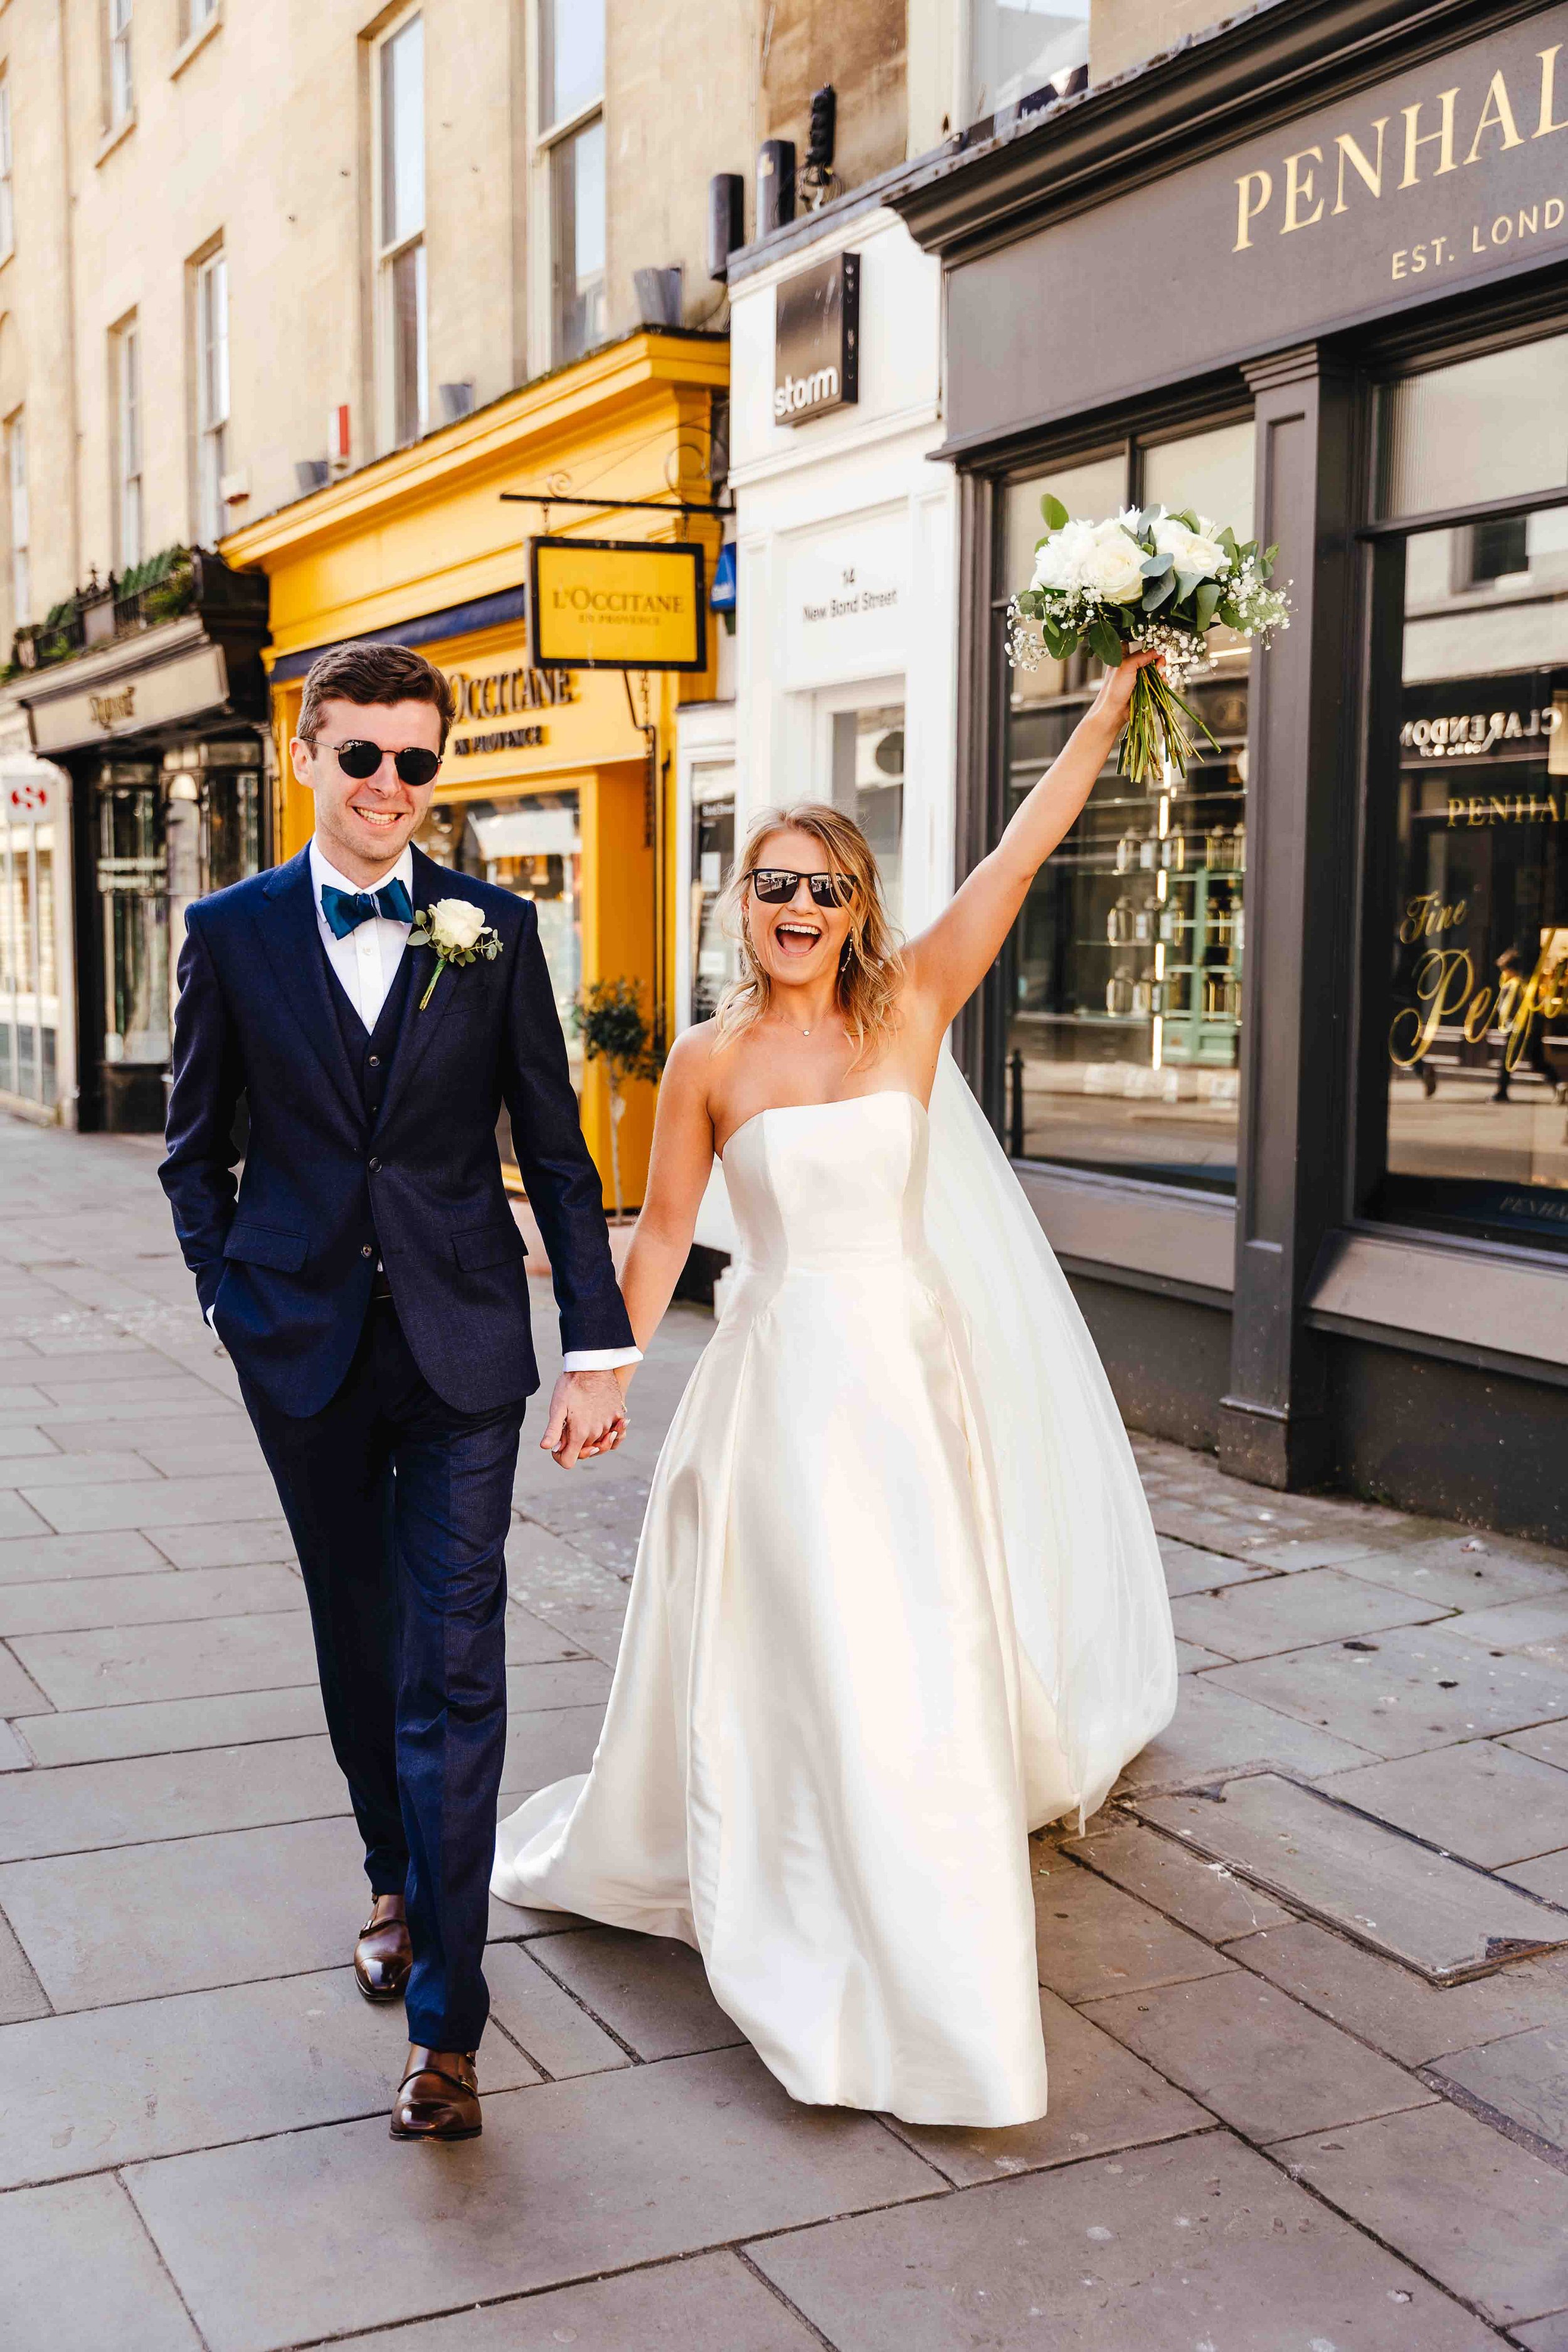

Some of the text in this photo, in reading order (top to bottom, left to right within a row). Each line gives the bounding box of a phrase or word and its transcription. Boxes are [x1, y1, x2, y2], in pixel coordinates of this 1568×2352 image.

[1231, 43, 1568, 253] PENHAL
[1391, 197, 1565, 280] EST. LOND
[774, 365, 838, 416] storm
[598, 614, 660, 626] PROVENCE
[803, 589, 896, 622] New Bond Street
[472, 725, 544, 754] PROVENCE
[1446, 793, 1568, 828] PENHA
[1399, 890, 1468, 944] Fine
